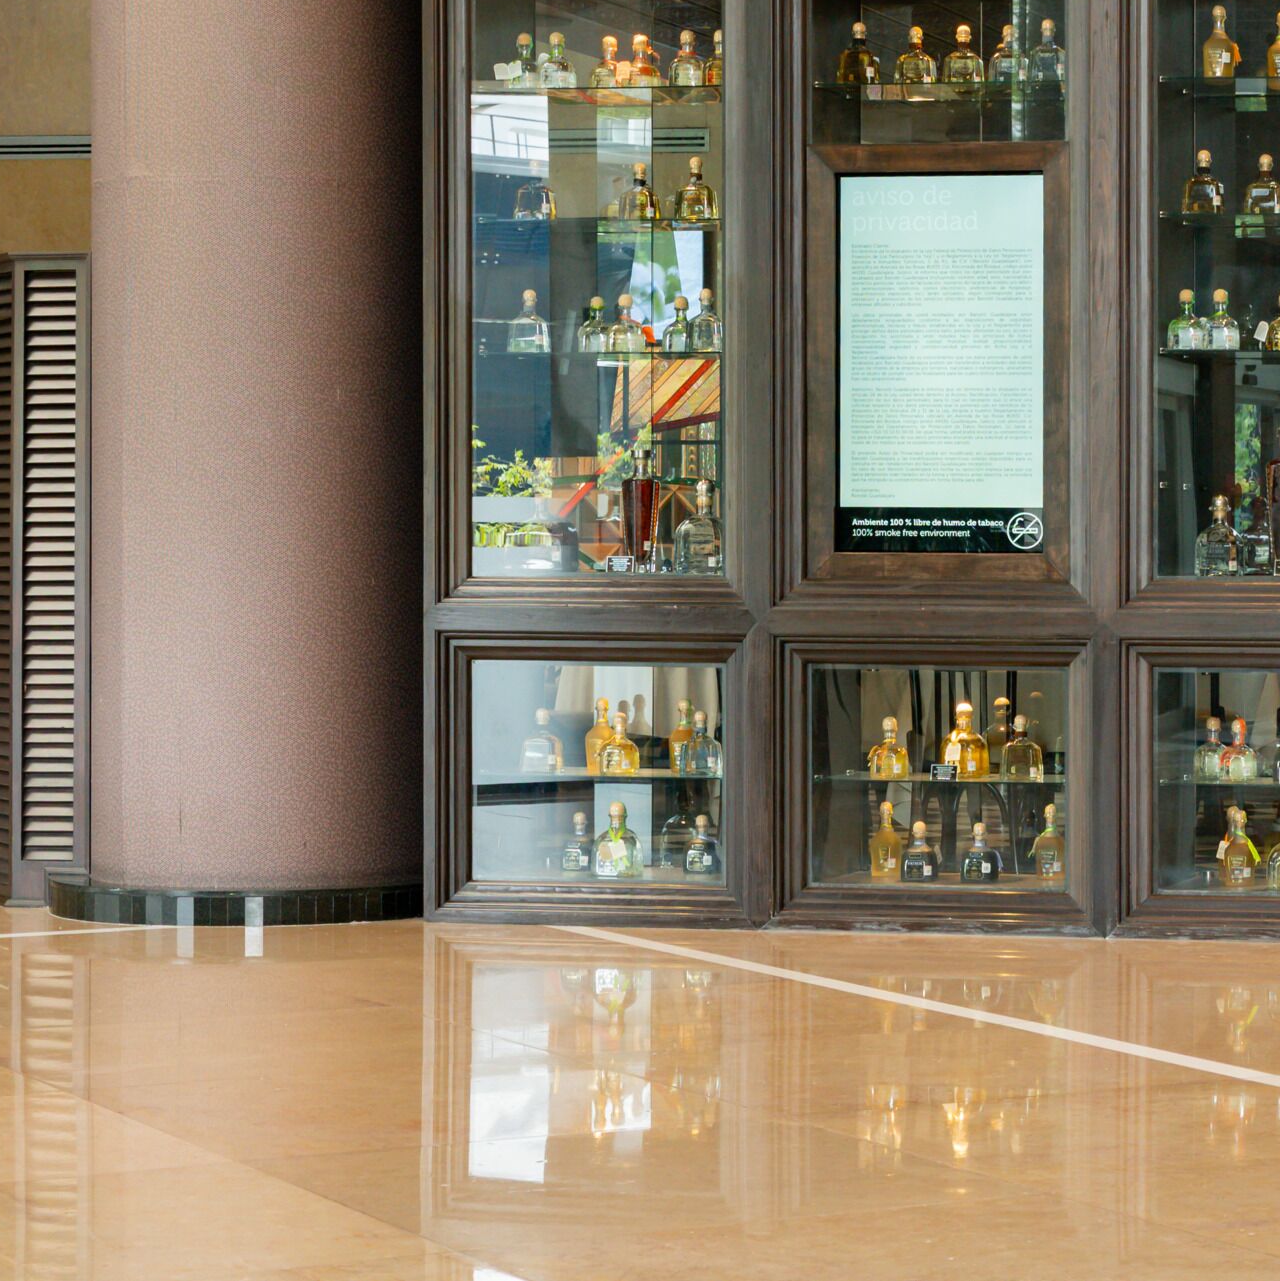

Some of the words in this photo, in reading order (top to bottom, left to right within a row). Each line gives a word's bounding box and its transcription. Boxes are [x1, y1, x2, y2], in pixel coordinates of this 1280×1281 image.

[851, 186, 914, 206] aviso
[922, 185, 952, 206] de
[851, 210, 979, 235] privacidad
[852, 518, 888, 526] Ambiente
[890, 518, 904, 526] 100
[905, 518, 912, 526] %
[913, 518, 931, 526] libre
[932, 518, 942, 526] de
[943, 518, 966, 526] humo
[967, 518, 977, 526] de
[978, 518, 1004, 526] tabaco
[852, 528, 873, 537] 100%
[874, 528, 901, 537] smoke
[902, 528, 918, 537] free
[920, 528, 971, 537] environment
